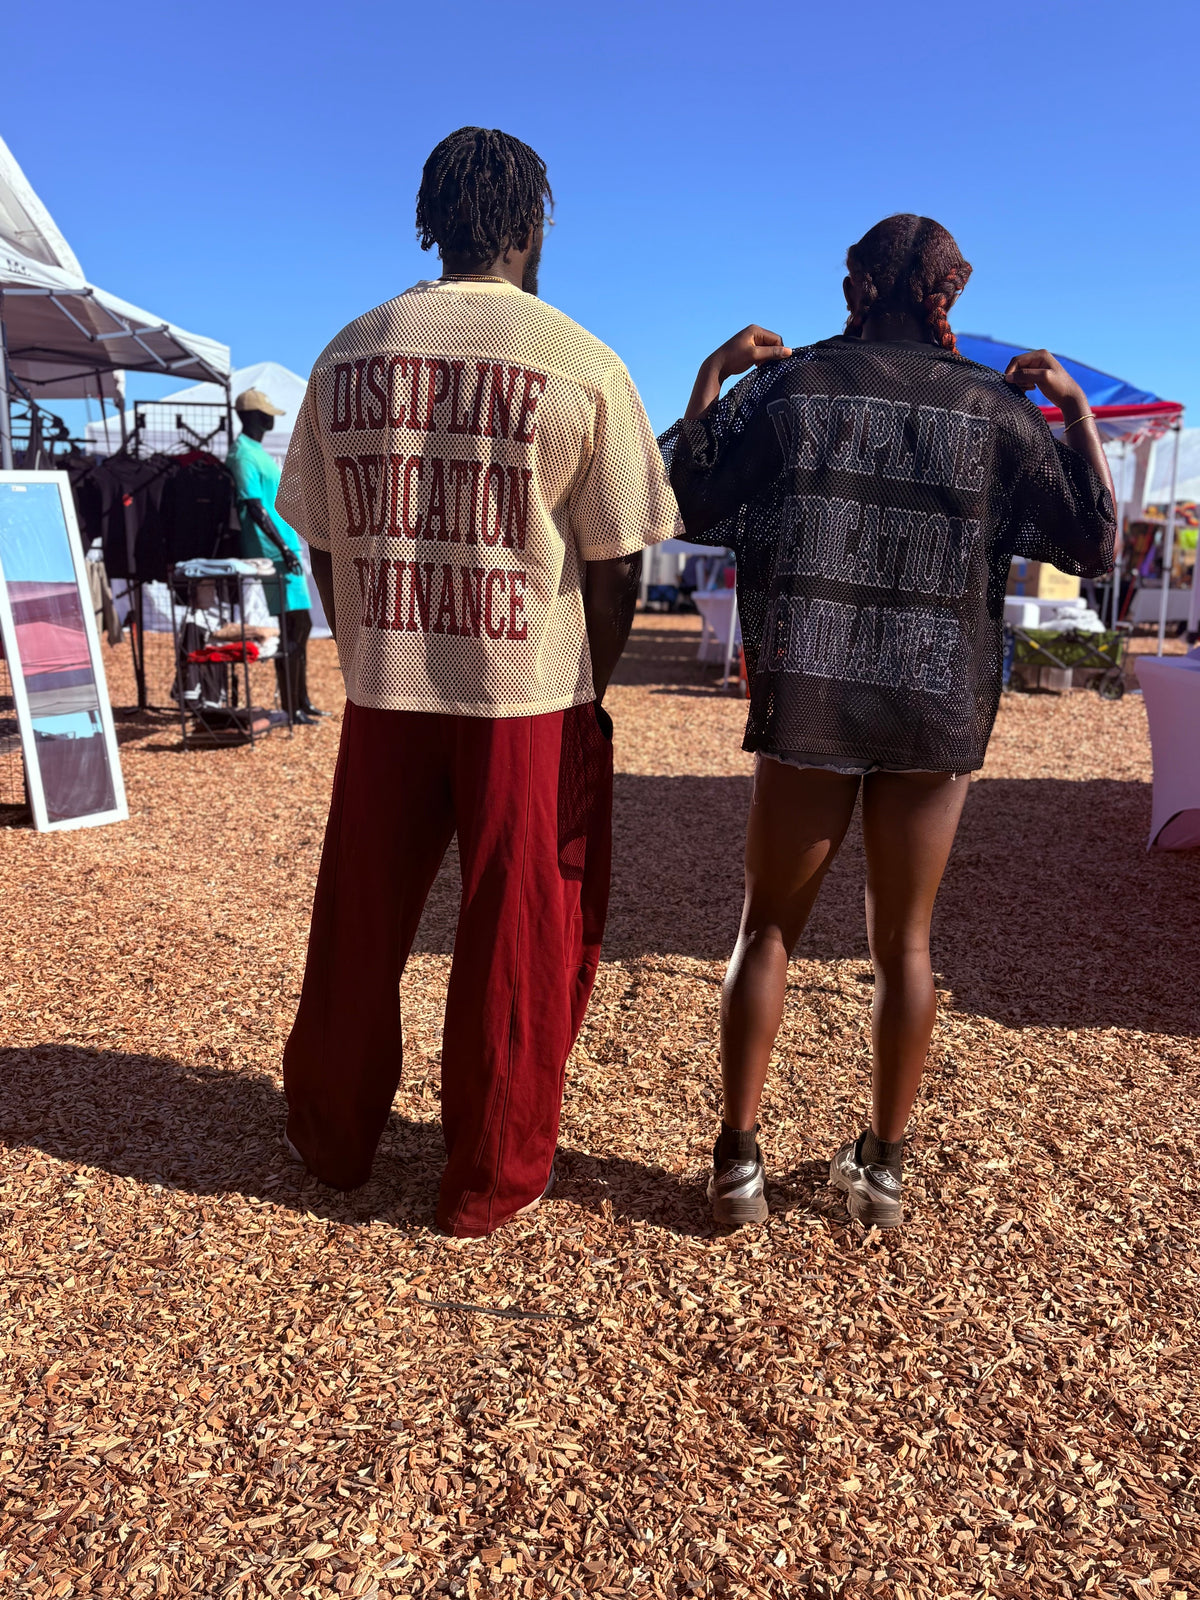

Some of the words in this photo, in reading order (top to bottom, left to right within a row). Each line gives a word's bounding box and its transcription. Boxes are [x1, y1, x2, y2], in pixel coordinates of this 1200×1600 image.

[330, 355, 547, 444] DISCIPLINE
[774, 495, 982, 599] EDICATION
[352, 557, 528, 641] MINANCE
